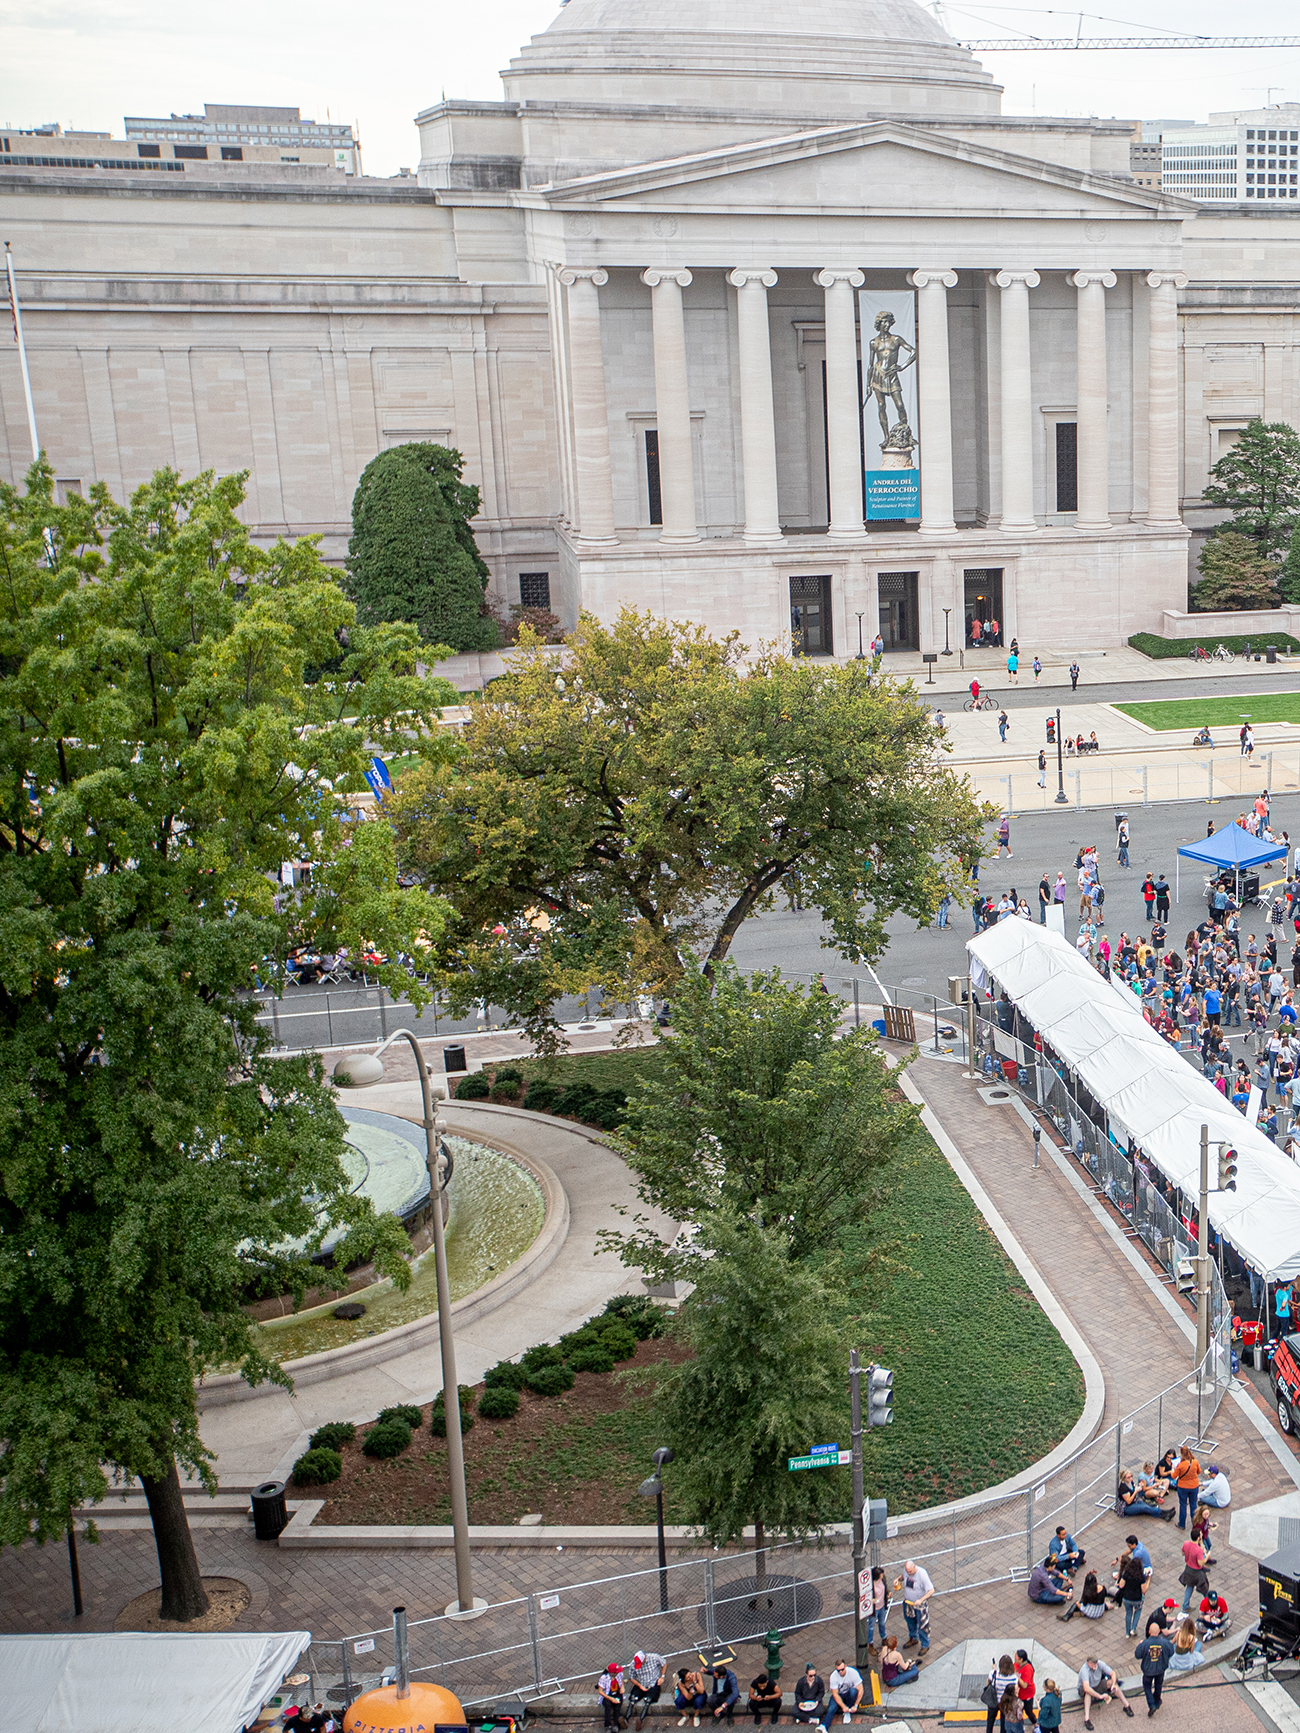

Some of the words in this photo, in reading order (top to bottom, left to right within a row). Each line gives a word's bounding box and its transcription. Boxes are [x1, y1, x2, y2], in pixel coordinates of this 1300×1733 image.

[868, 486, 918, 494] VERROCCHIO
[790, 1457, 829, 1469] Pennsylvania
[354, 1720, 425, 1733] PIZZERIA
